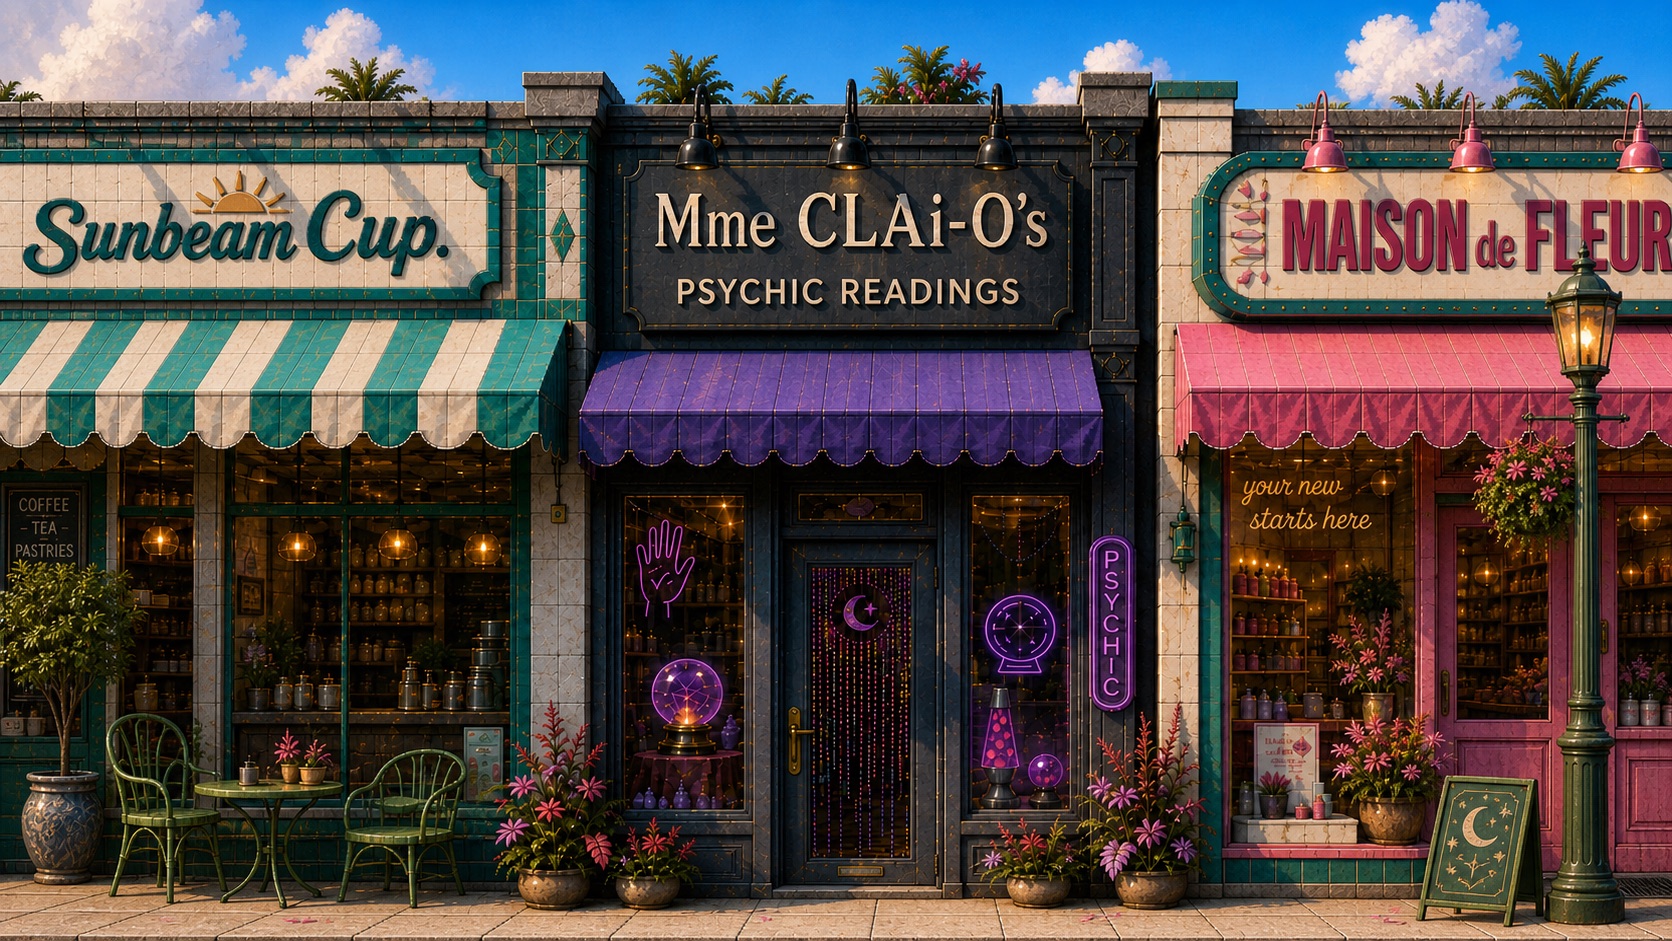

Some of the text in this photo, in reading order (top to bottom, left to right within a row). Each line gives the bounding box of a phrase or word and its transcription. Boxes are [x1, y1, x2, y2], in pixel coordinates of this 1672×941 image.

[22, 189, 450, 277] Sunbeam Cup.
[654, 191, 1048, 250] Mme CLAi-O's
[1281, 198, 1672, 273] MAISON de FLEUR
[676, 277, 1020, 306] PSYCHIC READINGS
[18, 497, 70, 512] COFFEE
[1241, 478, 1345, 506] your new
[31, 520, 58, 535] TEA
[1249, 505, 1373, 530] starts here
[15, 543, 74, 558] PASTRIES
[1102, 549, 1121, 697] PSYCHIC
